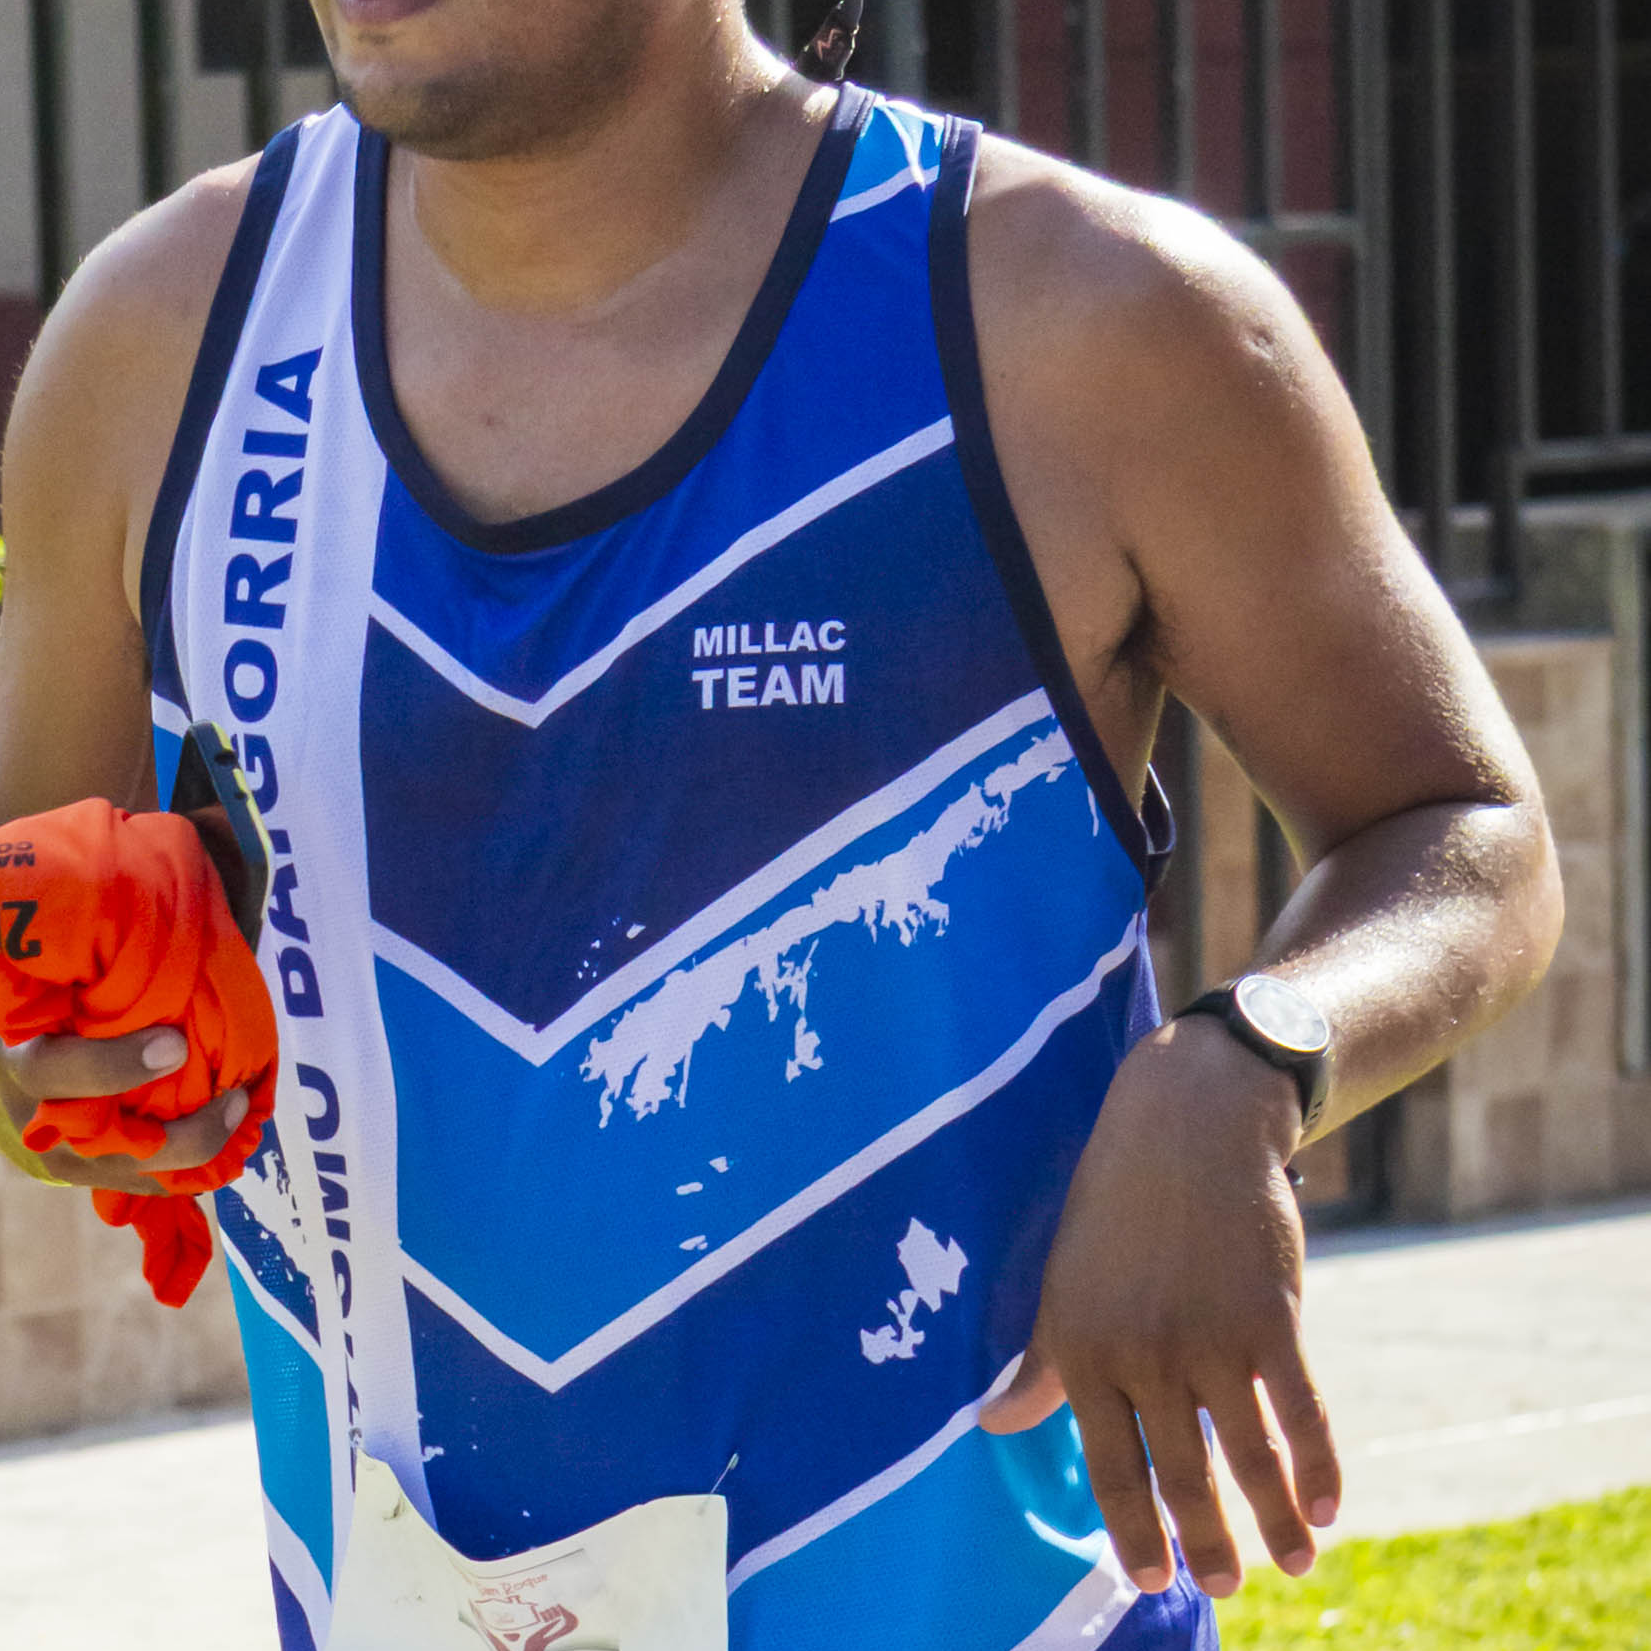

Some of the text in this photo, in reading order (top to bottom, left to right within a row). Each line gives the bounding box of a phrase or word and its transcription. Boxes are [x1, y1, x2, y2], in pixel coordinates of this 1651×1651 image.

[693, 619, 847, 658] MILLAC
[223, 345, 324, 1018] BAGORRIA
[691, 663, 845, 710] TEAM
